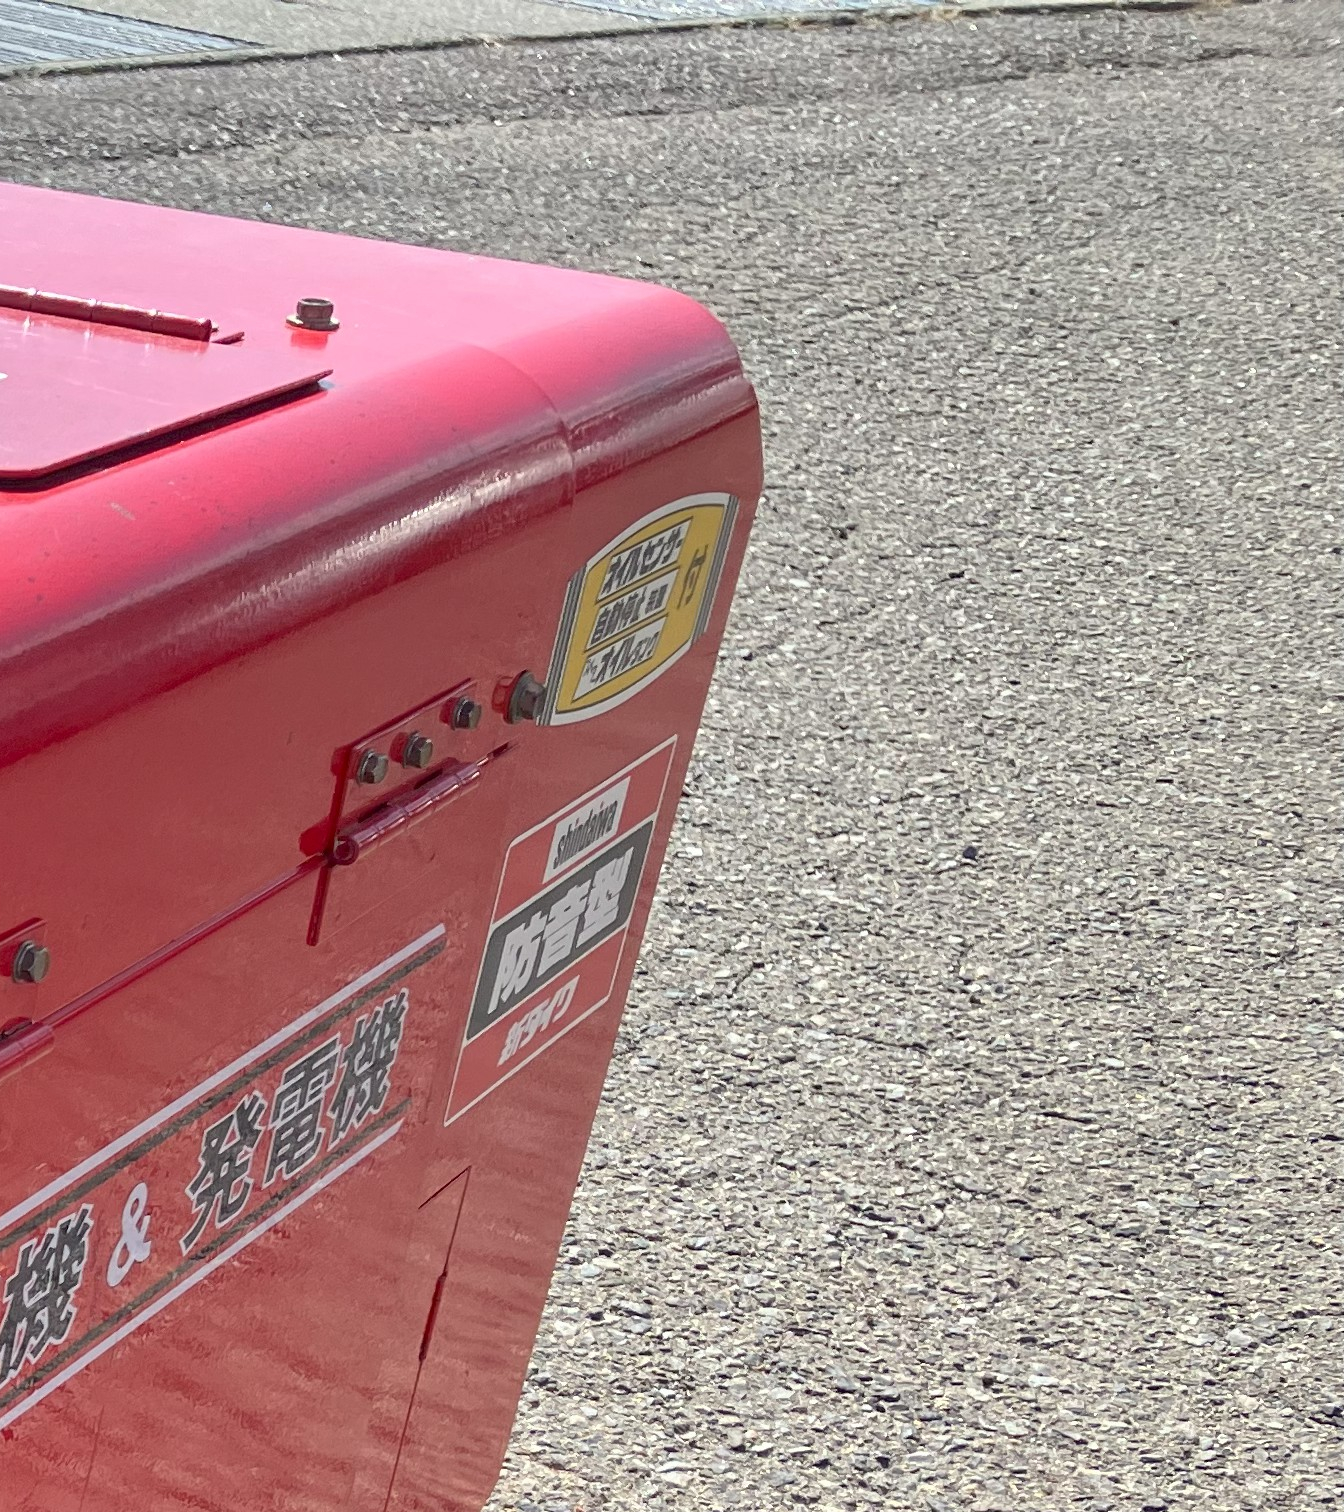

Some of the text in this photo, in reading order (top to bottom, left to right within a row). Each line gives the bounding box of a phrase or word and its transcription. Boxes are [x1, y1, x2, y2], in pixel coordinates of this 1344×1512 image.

[553, 800, 618, 870] shindaiwa
[487, 847, 635, 1014] 防音型
[105, 1181, 153, 1288] &
[179, 988, 411, 1253] 発電機
